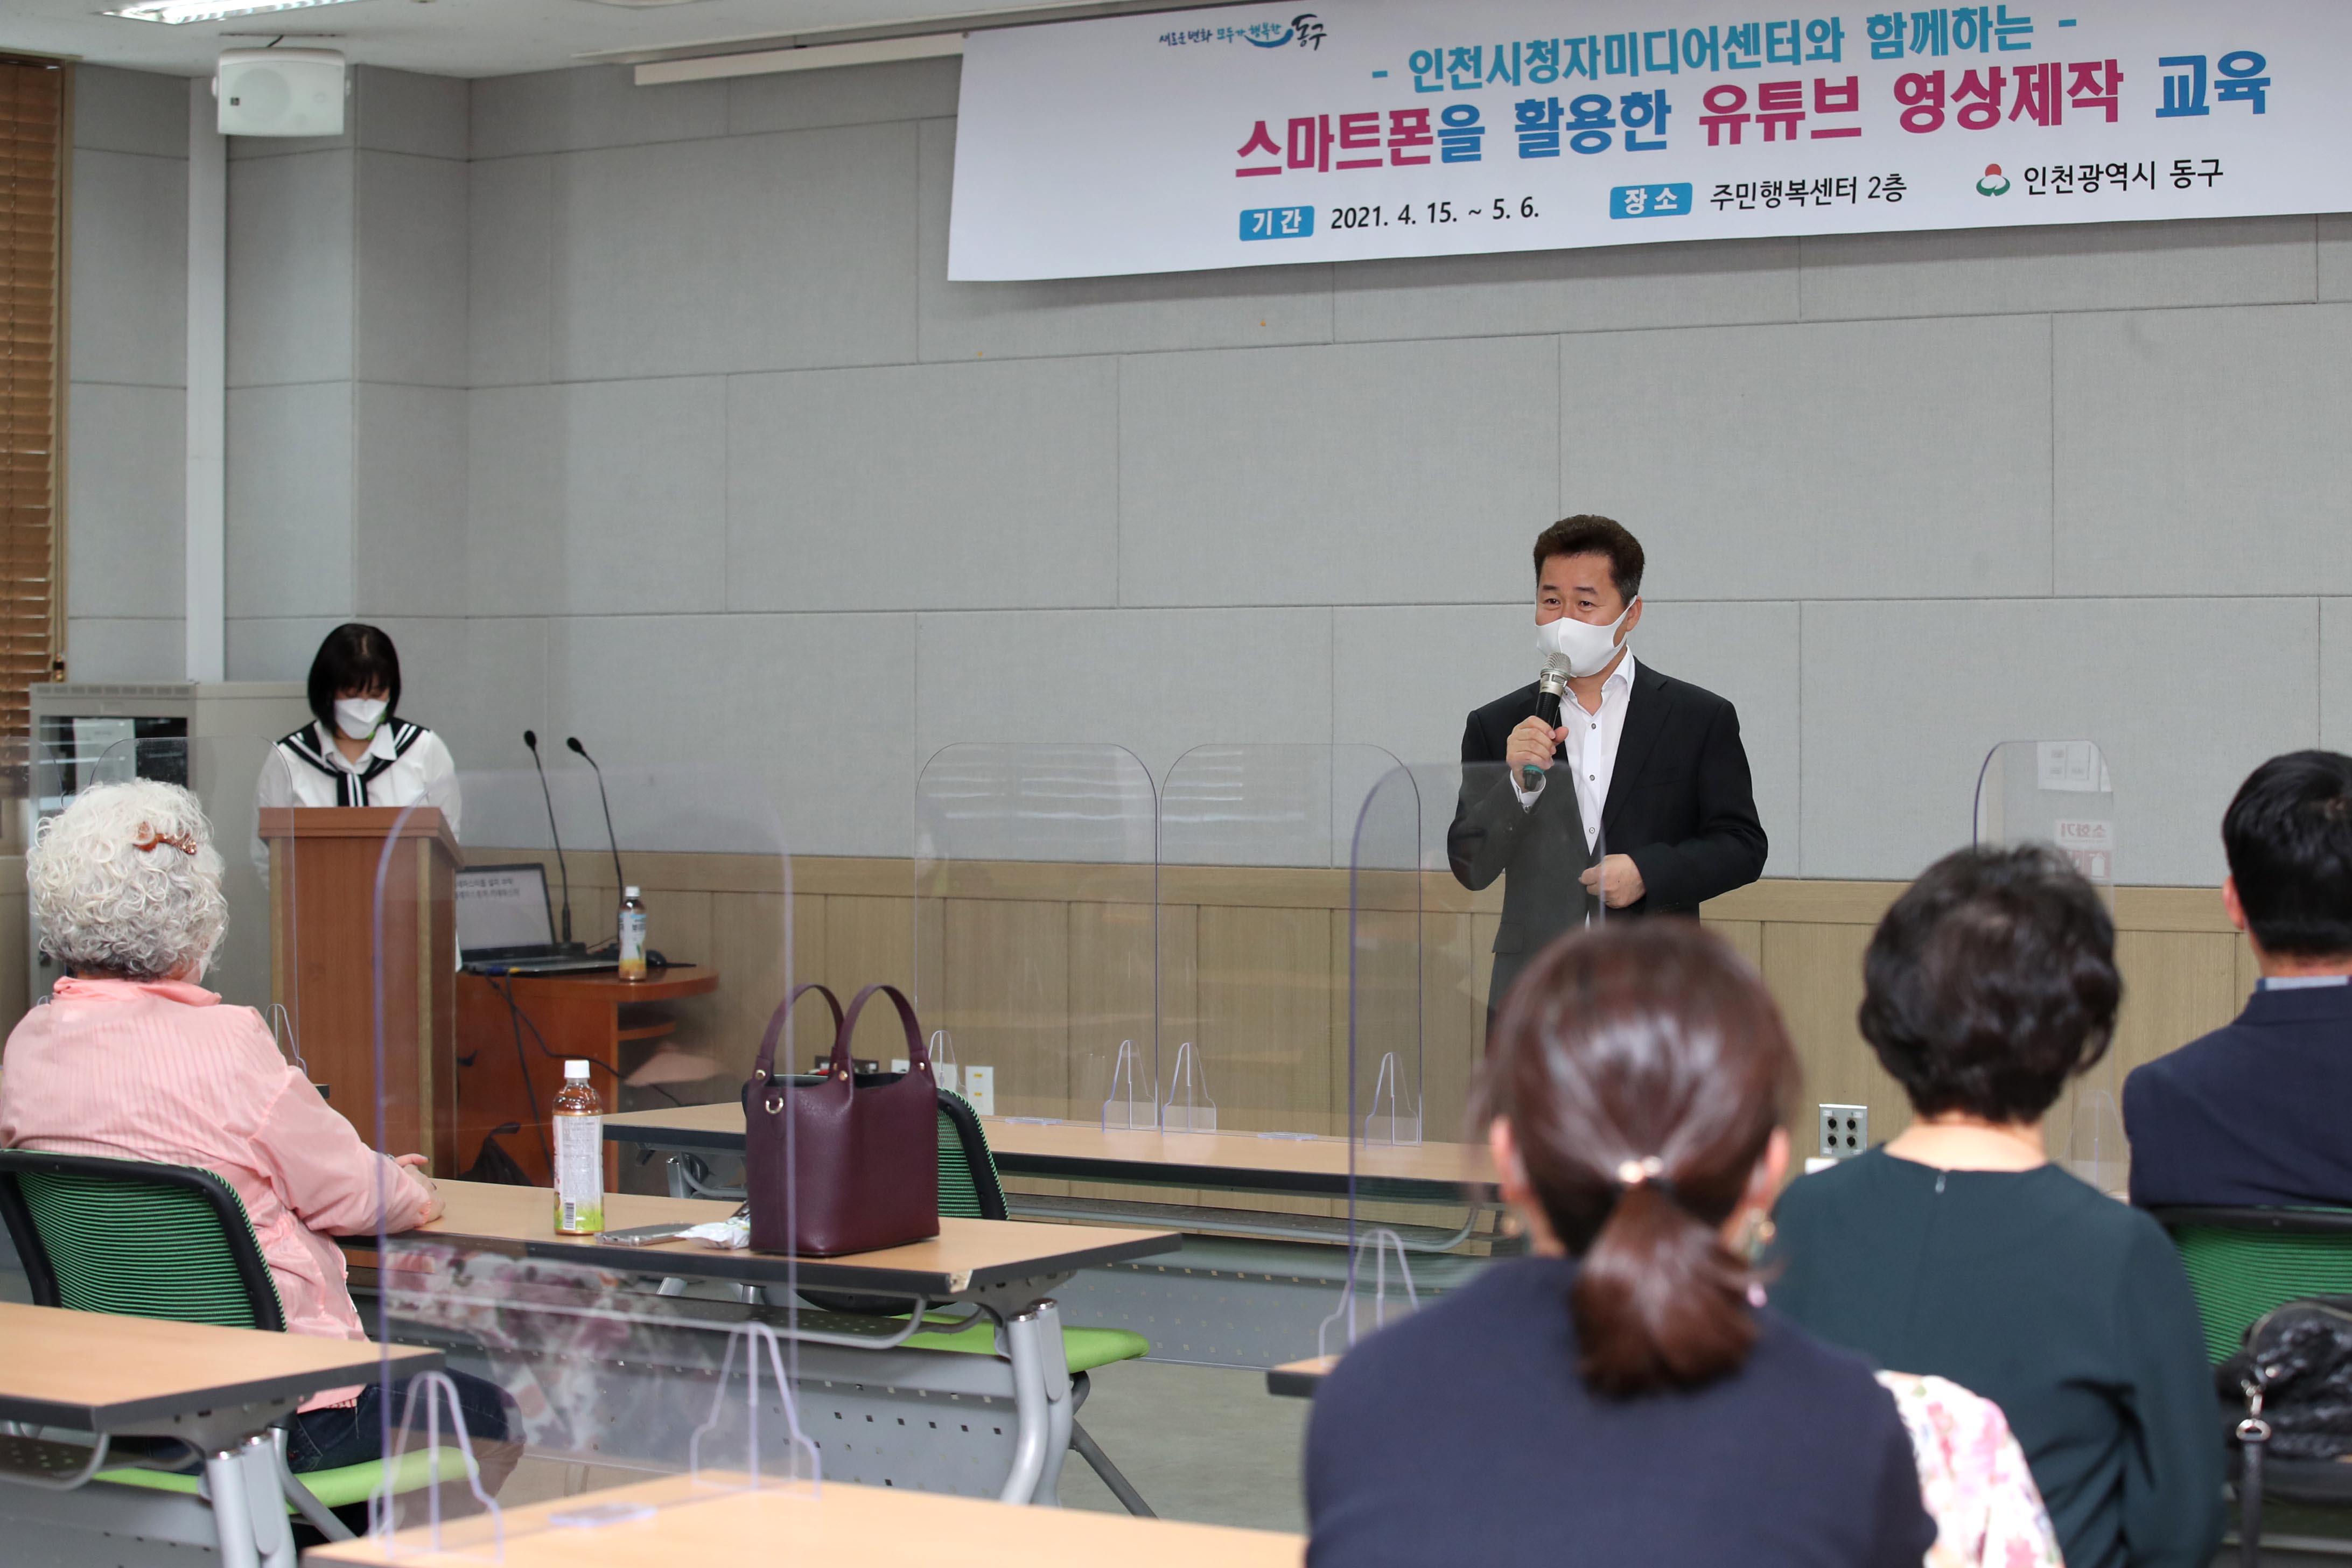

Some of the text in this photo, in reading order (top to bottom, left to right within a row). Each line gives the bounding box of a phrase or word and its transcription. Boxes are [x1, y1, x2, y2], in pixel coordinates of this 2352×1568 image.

[1249, 23, 1283, 40] 행복한
[1291, 13, 1327, 51] 동구
[1409, 17, 1845, 93] 인천시청자미디어센터와
[1866, 4, 2033, 60] 함께하는
[1236, 51, 2271, 178] 스마트폰을 활용한 유튜브 영상제작 교육
[1710, 176, 1857, 211] 주민행복센터
[1868, 173, 1907, 202] 2층
[2024, 159, 2223, 195] 인천광역시 동구
[1331, 206, 1388, 229] 2021.
[1397, 204, 1416, 225] 4.
[1427, 201, 1457, 223] 15.
[1493, 198, 1510, 220] 5.
[1521, 196, 1539, 218] 6.
